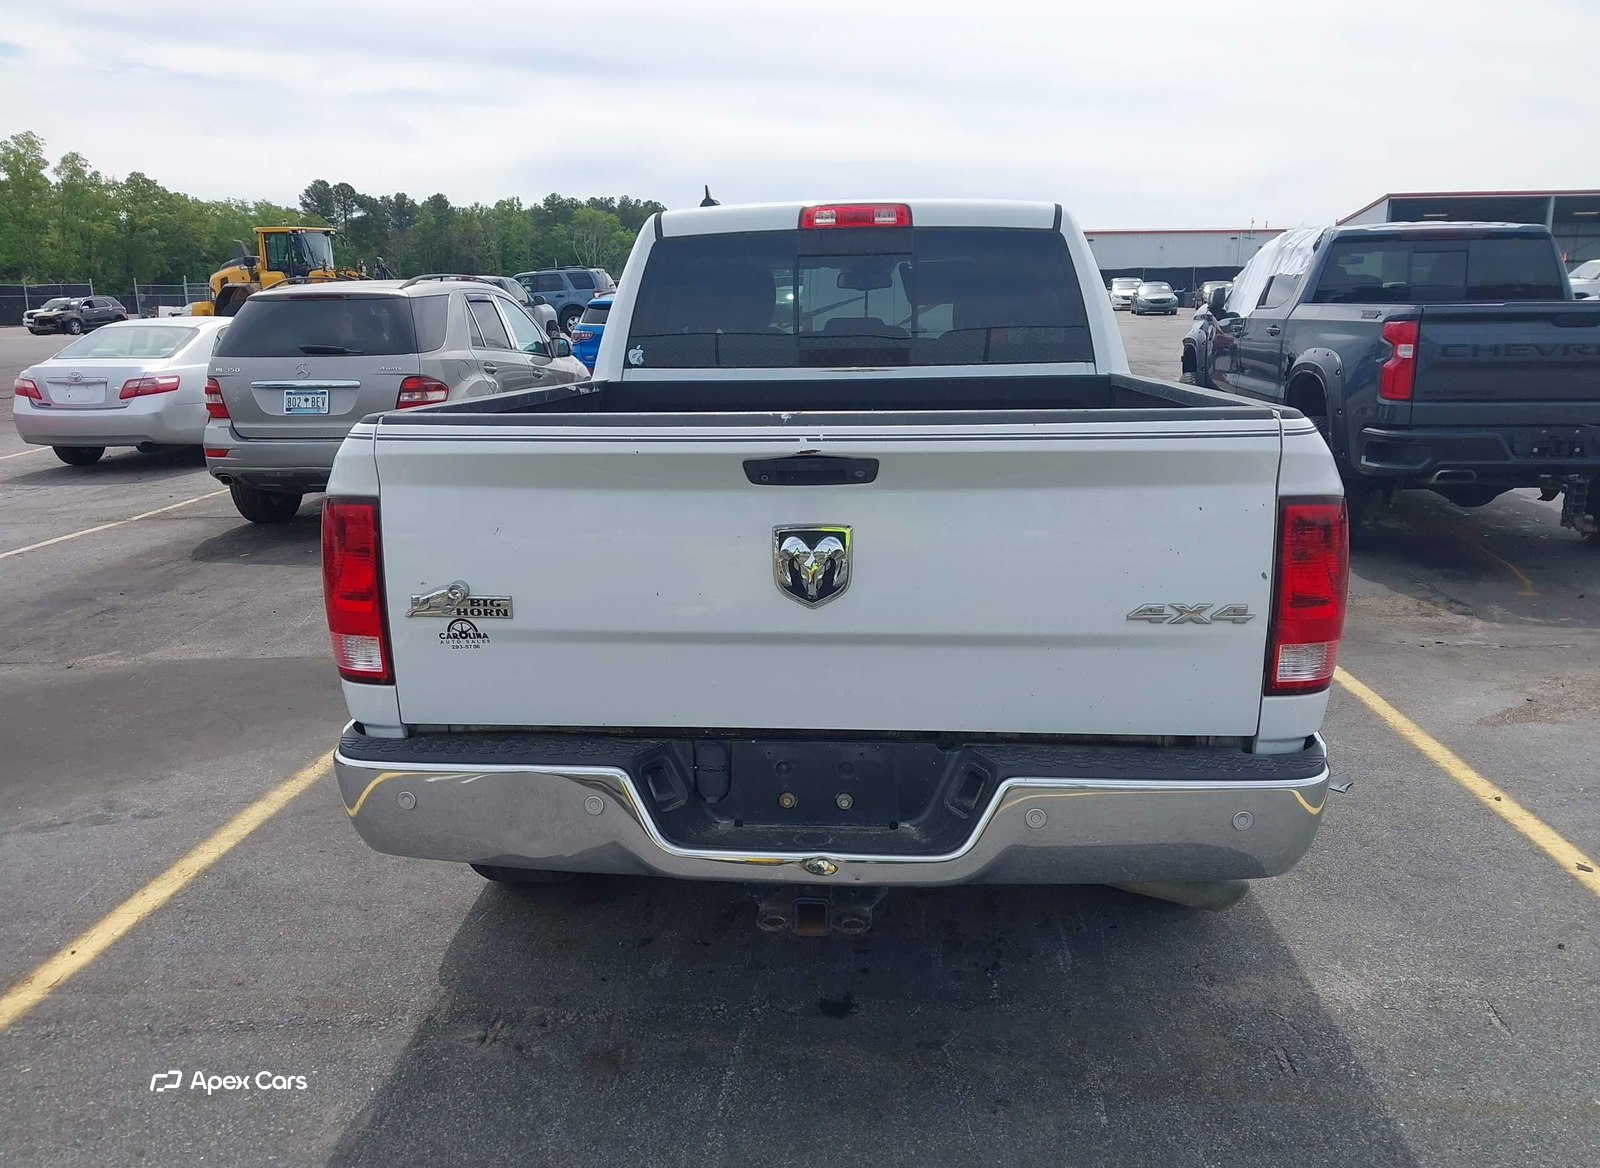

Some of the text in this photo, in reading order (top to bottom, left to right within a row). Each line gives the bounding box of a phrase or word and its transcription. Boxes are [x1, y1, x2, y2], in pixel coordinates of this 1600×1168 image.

[287, 396, 326, 407] 802 BEV
[470, 598, 501, 607] BIG
[456, 608, 509, 616] HORN
[1126, 602, 1256, 624] 4X4
[439, 631, 490, 640] CAROLINA
